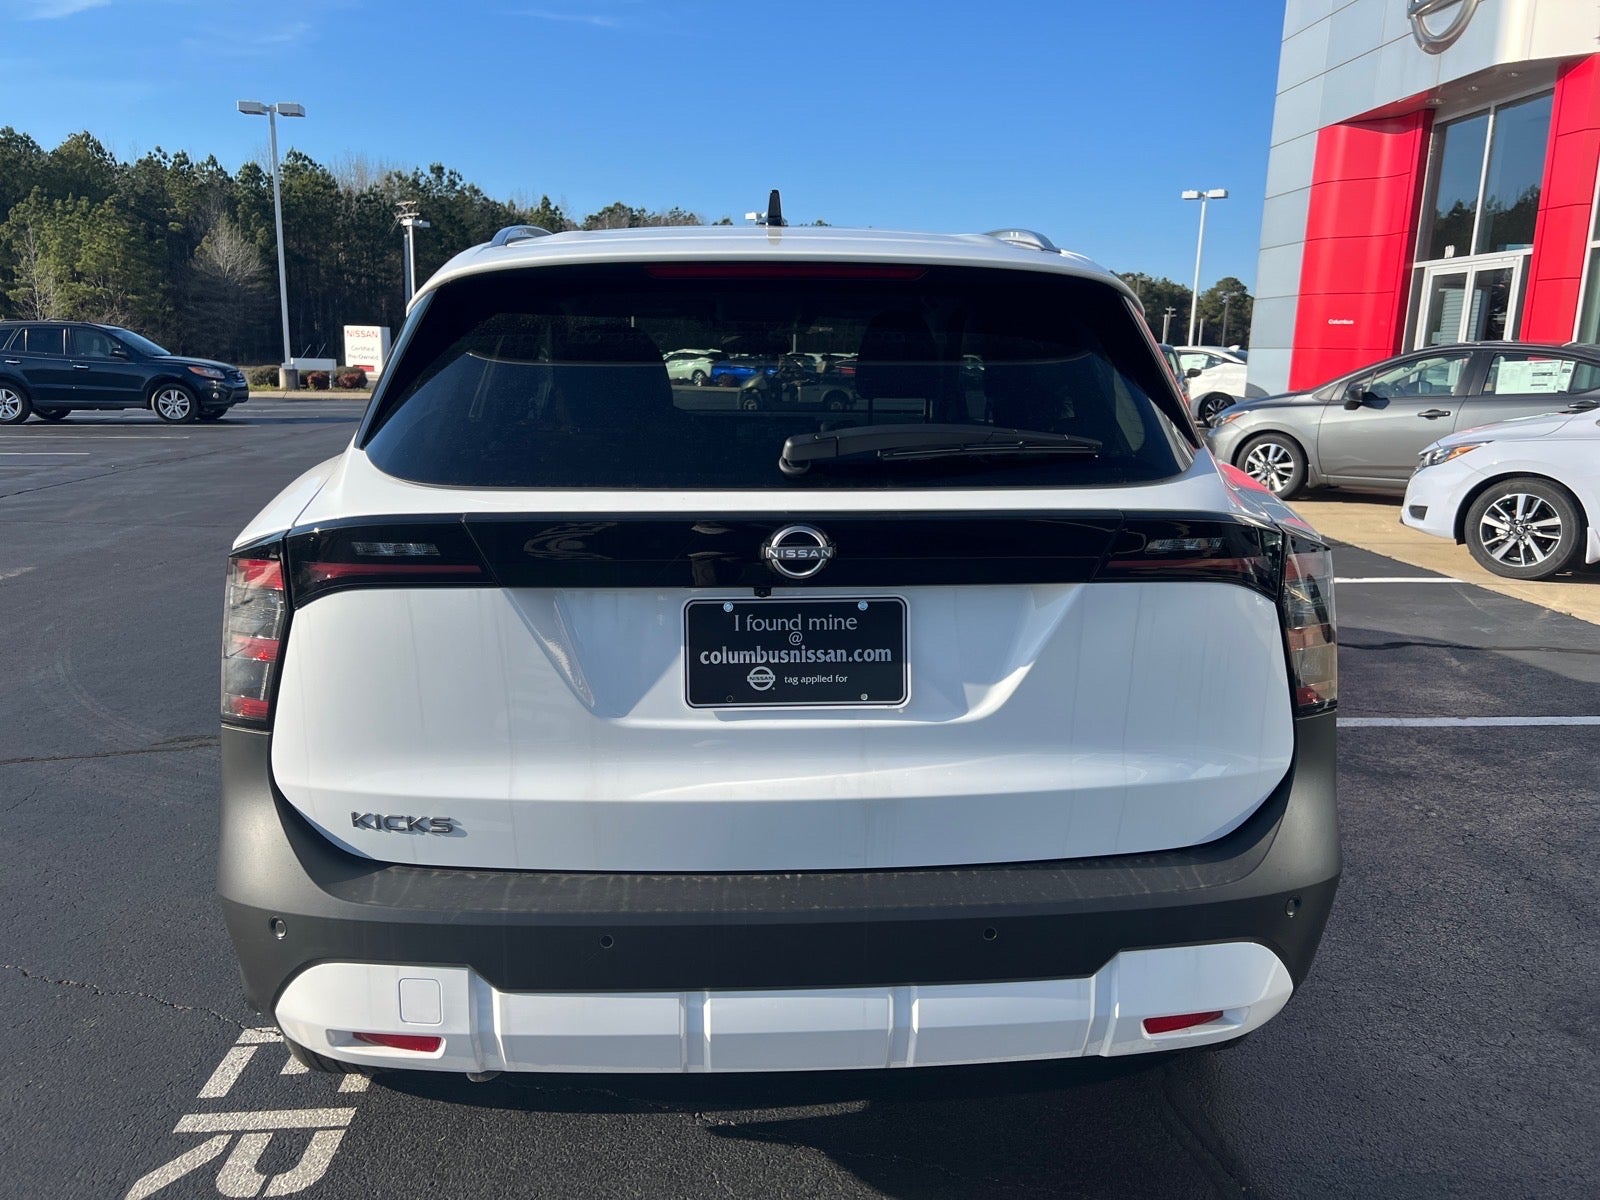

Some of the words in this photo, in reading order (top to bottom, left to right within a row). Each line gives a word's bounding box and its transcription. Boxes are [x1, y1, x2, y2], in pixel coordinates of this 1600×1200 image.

[347, 330, 378, 338] NISSAN
[768, 549, 831, 558] NISSAN
[734, 614, 740, 632] I
[746, 613, 802, 632] found
[808, 613, 858, 631] mine
[788, 631, 803, 646] @
[699, 645, 892, 665] columbusnissan.com
[784, 675, 799, 685] tag
[800, 674, 833, 685] applied
[835, 674, 848, 683] for
[351, 811, 454, 833] KICKS
